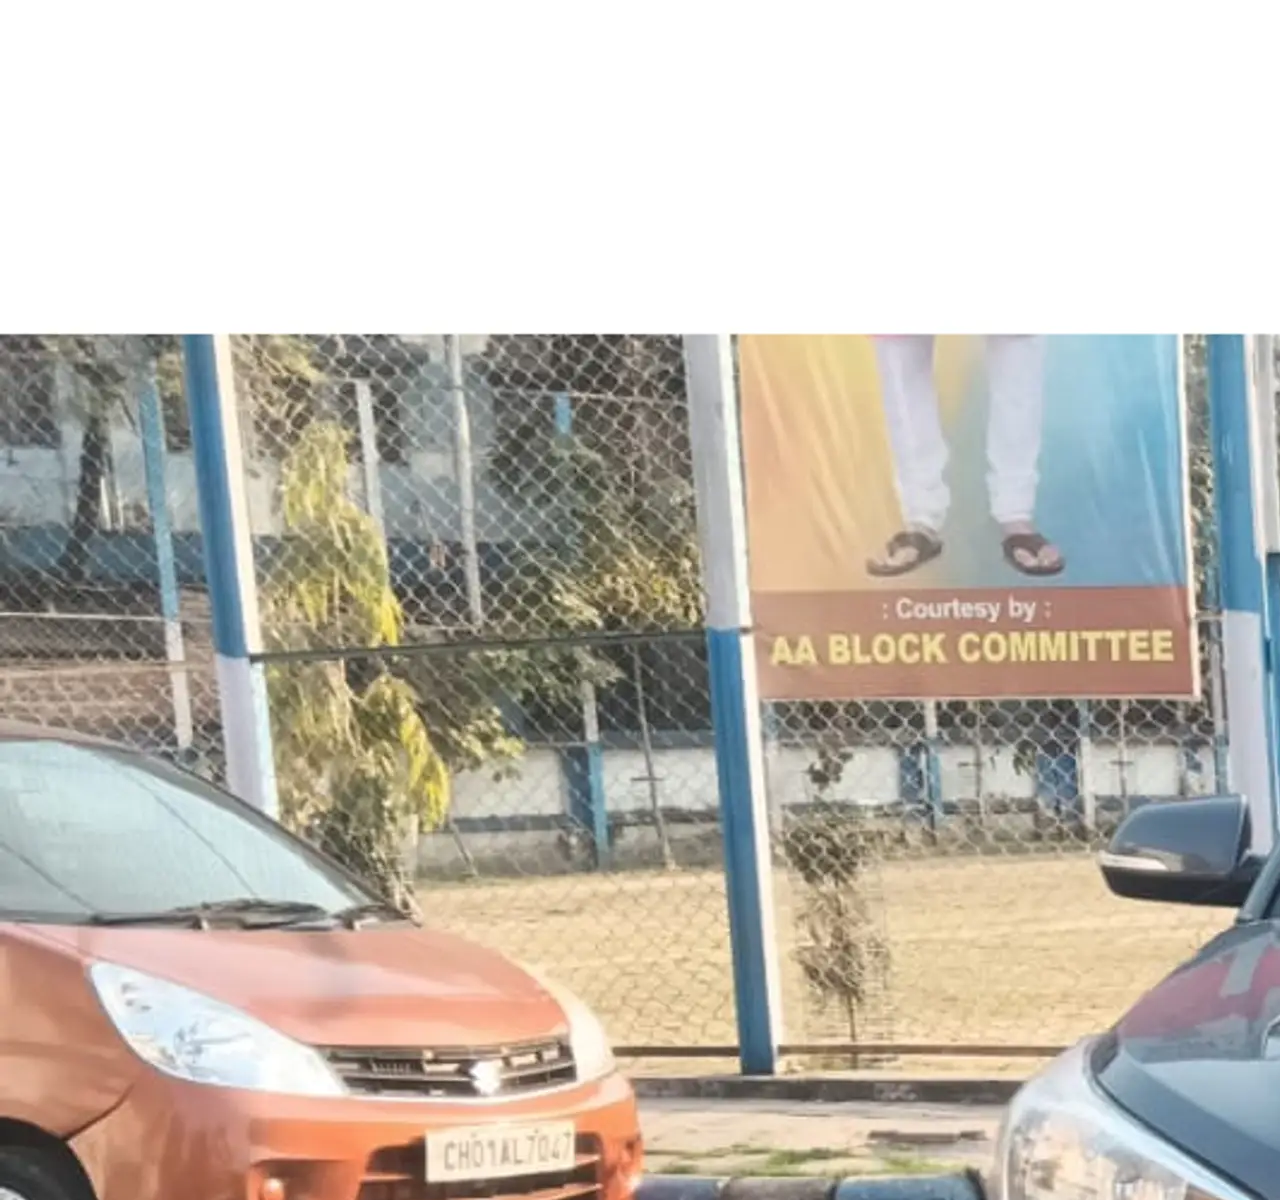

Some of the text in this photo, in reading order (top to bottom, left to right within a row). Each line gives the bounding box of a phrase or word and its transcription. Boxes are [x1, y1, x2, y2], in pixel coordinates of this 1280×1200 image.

[895, 597, 1001, 622] Courtesy
[1008, 596, 1037, 622] by
[769, 629, 1175, 666] AA BLOCK COMMITTEE
[443, 1131, 572, 1171] CH01AL7047
